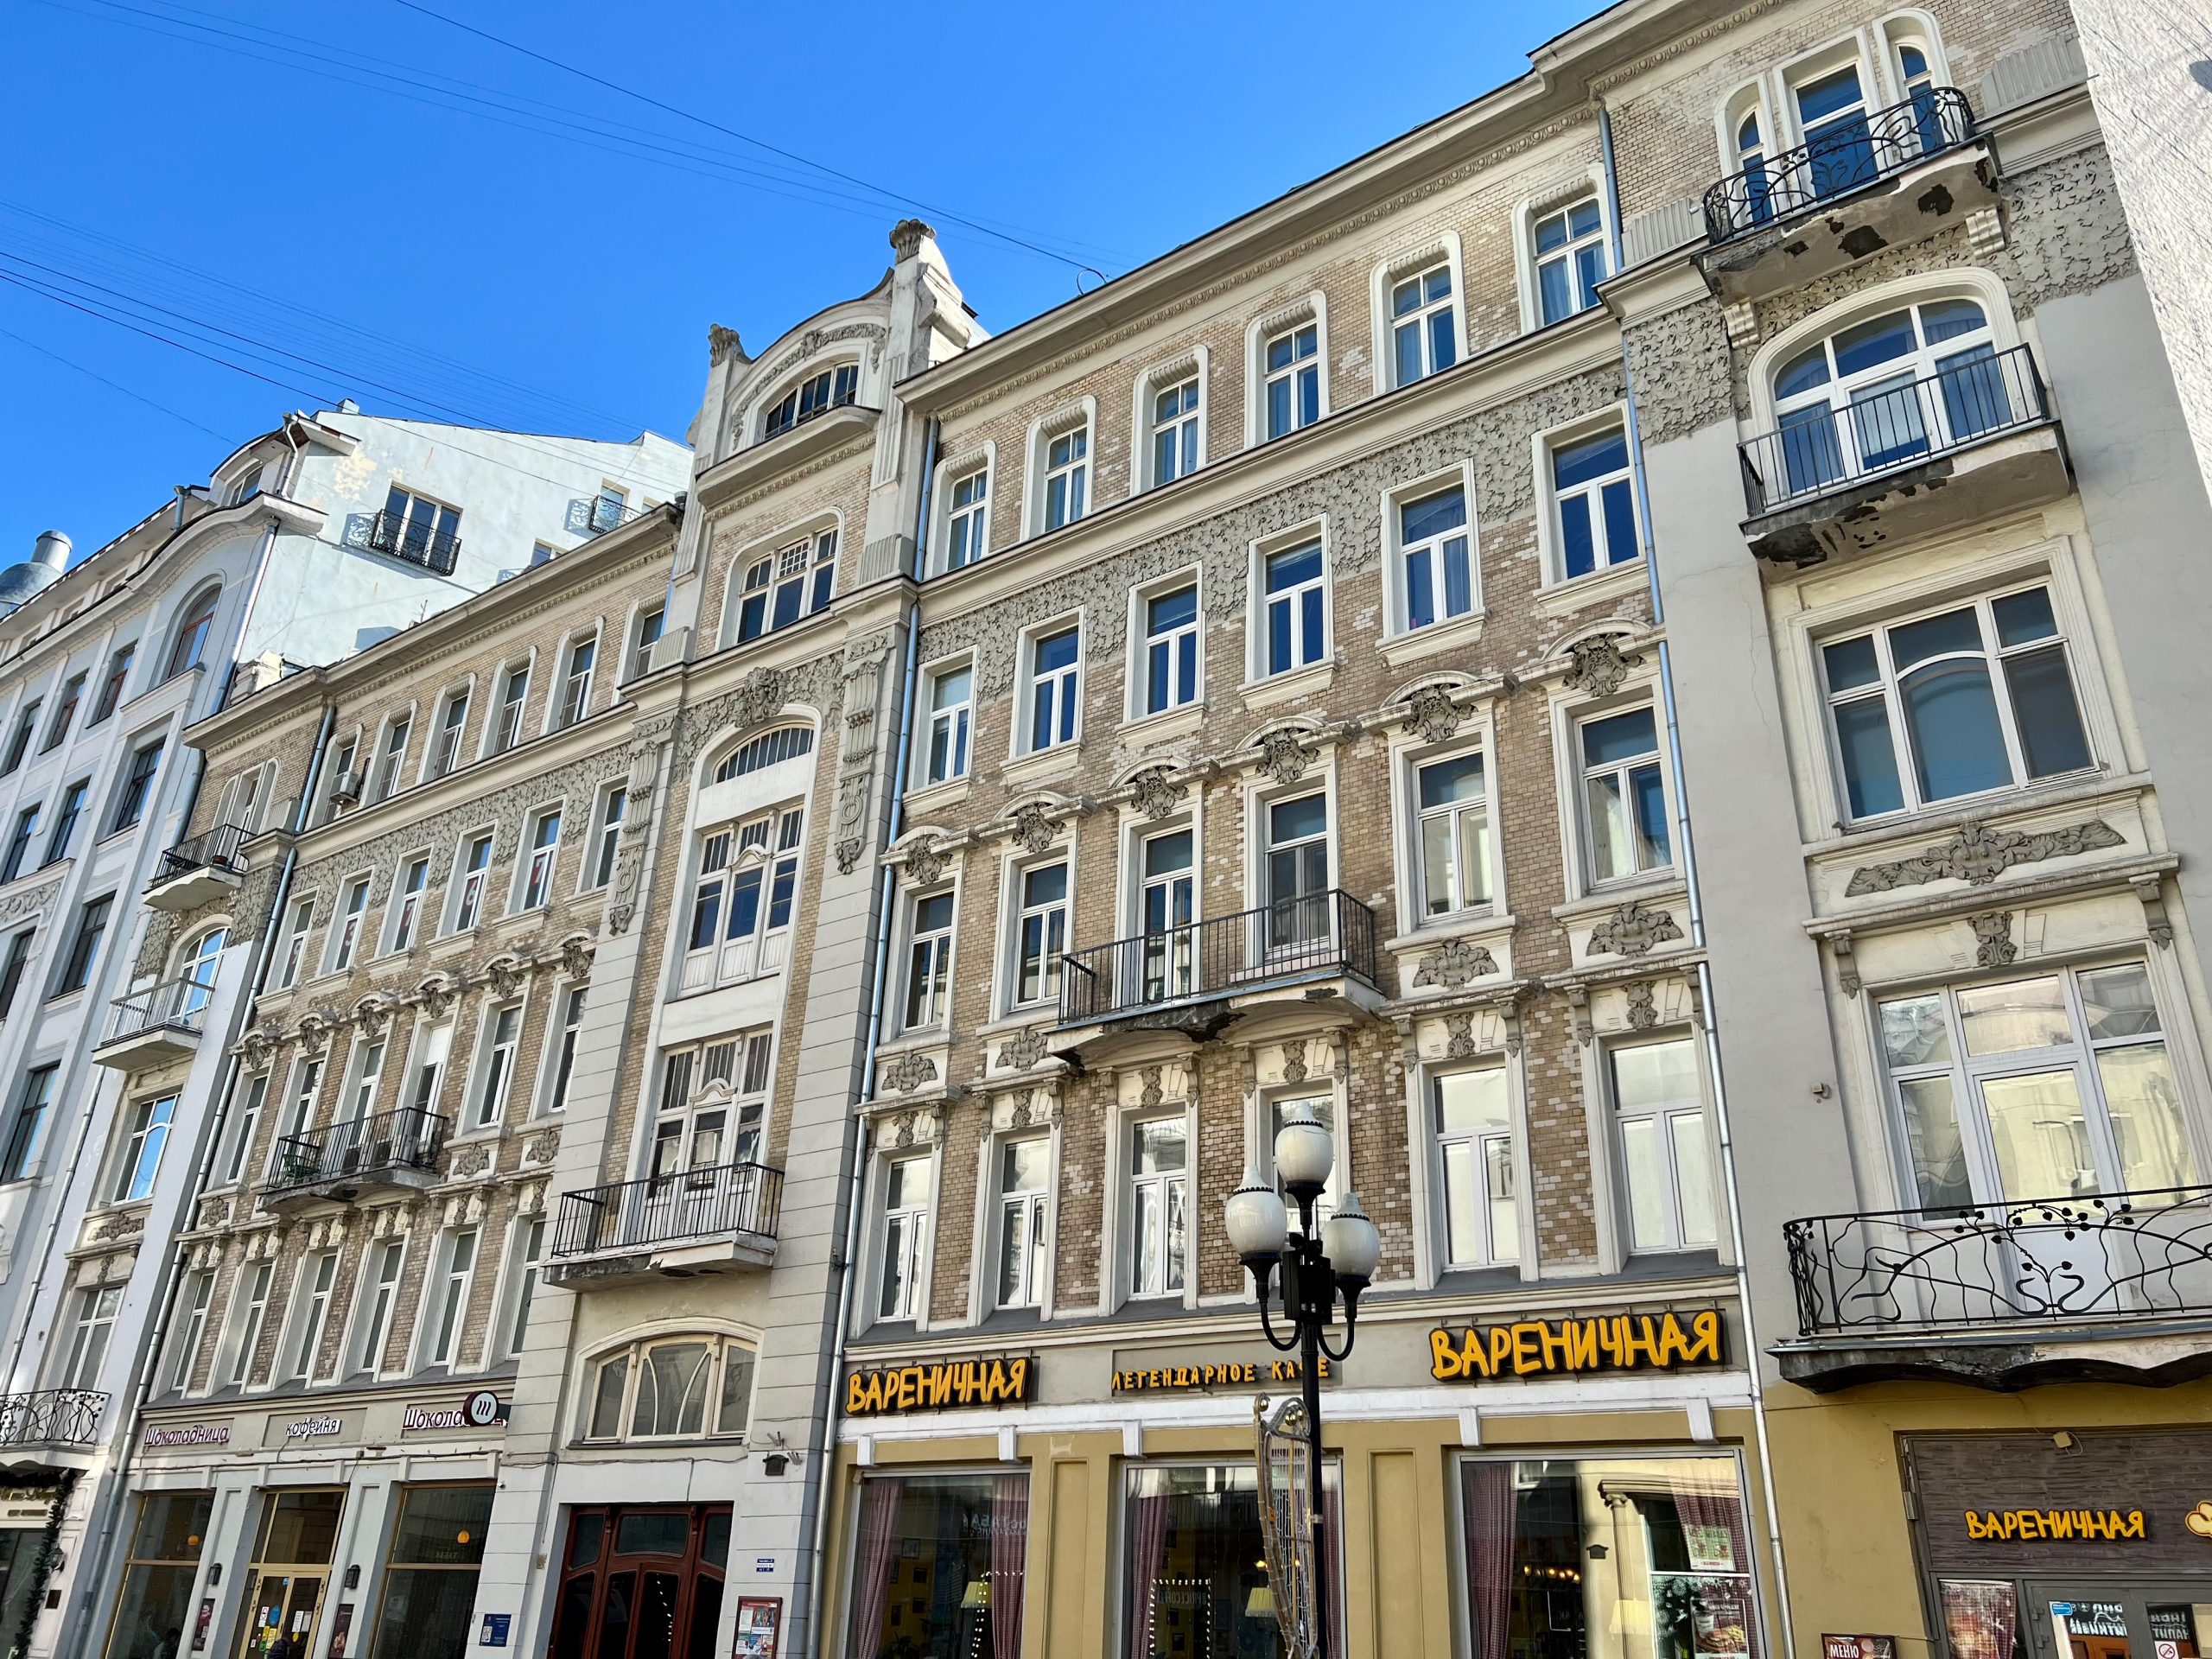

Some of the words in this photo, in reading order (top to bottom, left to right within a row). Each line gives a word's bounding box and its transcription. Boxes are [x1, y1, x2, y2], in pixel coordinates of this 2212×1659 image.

[1431, 1311, 1719, 1379] ВАРЕНИЧНАЯ
[846, 1358, 1027, 1413] ВАРЕНИЧНАЯ
[1112, 1363, 1255, 1390] ЛЕГЕНДАРНОЕ
[1271, 1357, 1329, 1381] КАЕ
[144, 1425, 229, 1446] Шоколадница
[285, 1415, 340, 1441] кофейня
[1965, 1510, 2145, 1540] ВАРЕНИЧНАЯ
[1830, 1644, 1859, 1658] МЕНЮ
